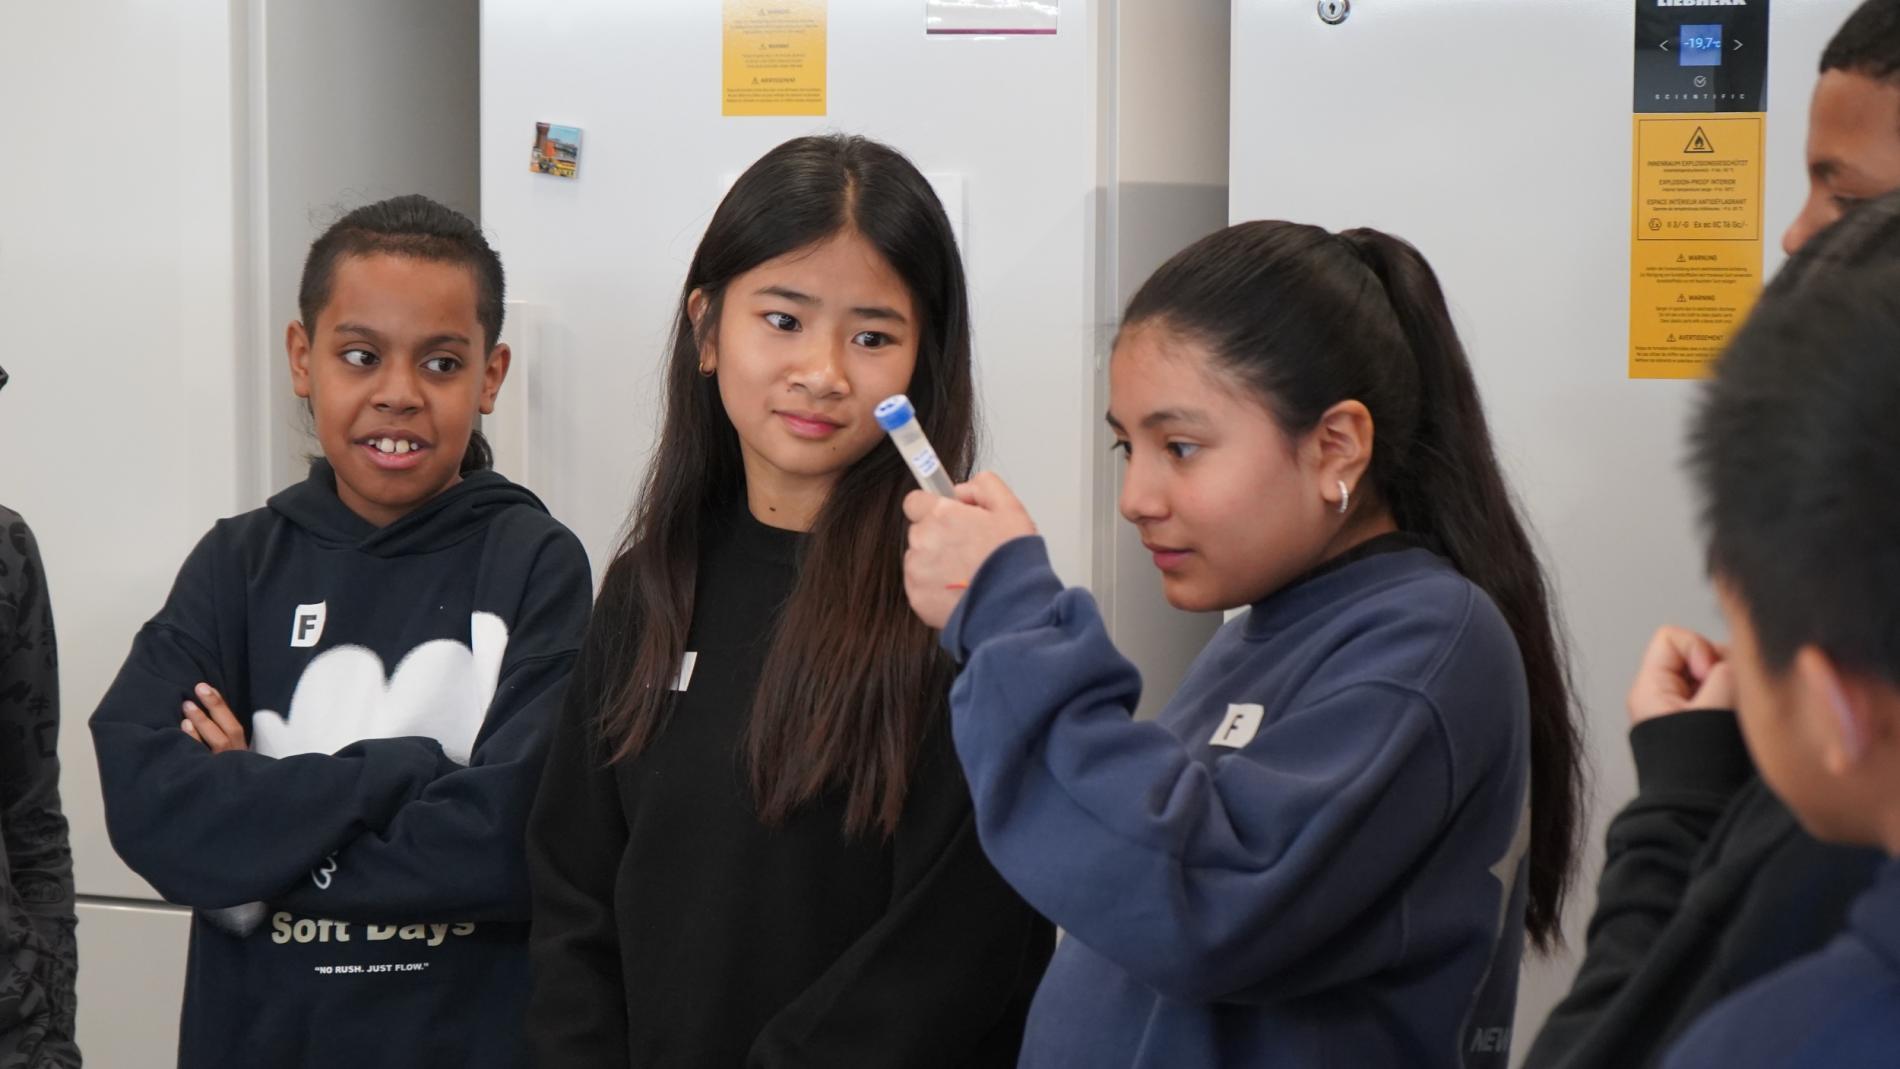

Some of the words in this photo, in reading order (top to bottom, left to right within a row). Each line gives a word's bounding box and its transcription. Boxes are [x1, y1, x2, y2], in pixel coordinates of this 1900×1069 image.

[298, 615, 317, 640] F
[1223, 714, 1244, 740] F
[271, 911, 350, 944] Soft
[335, 965, 365, 974] RUSH.
[366, 964, 393, 973] JUST
